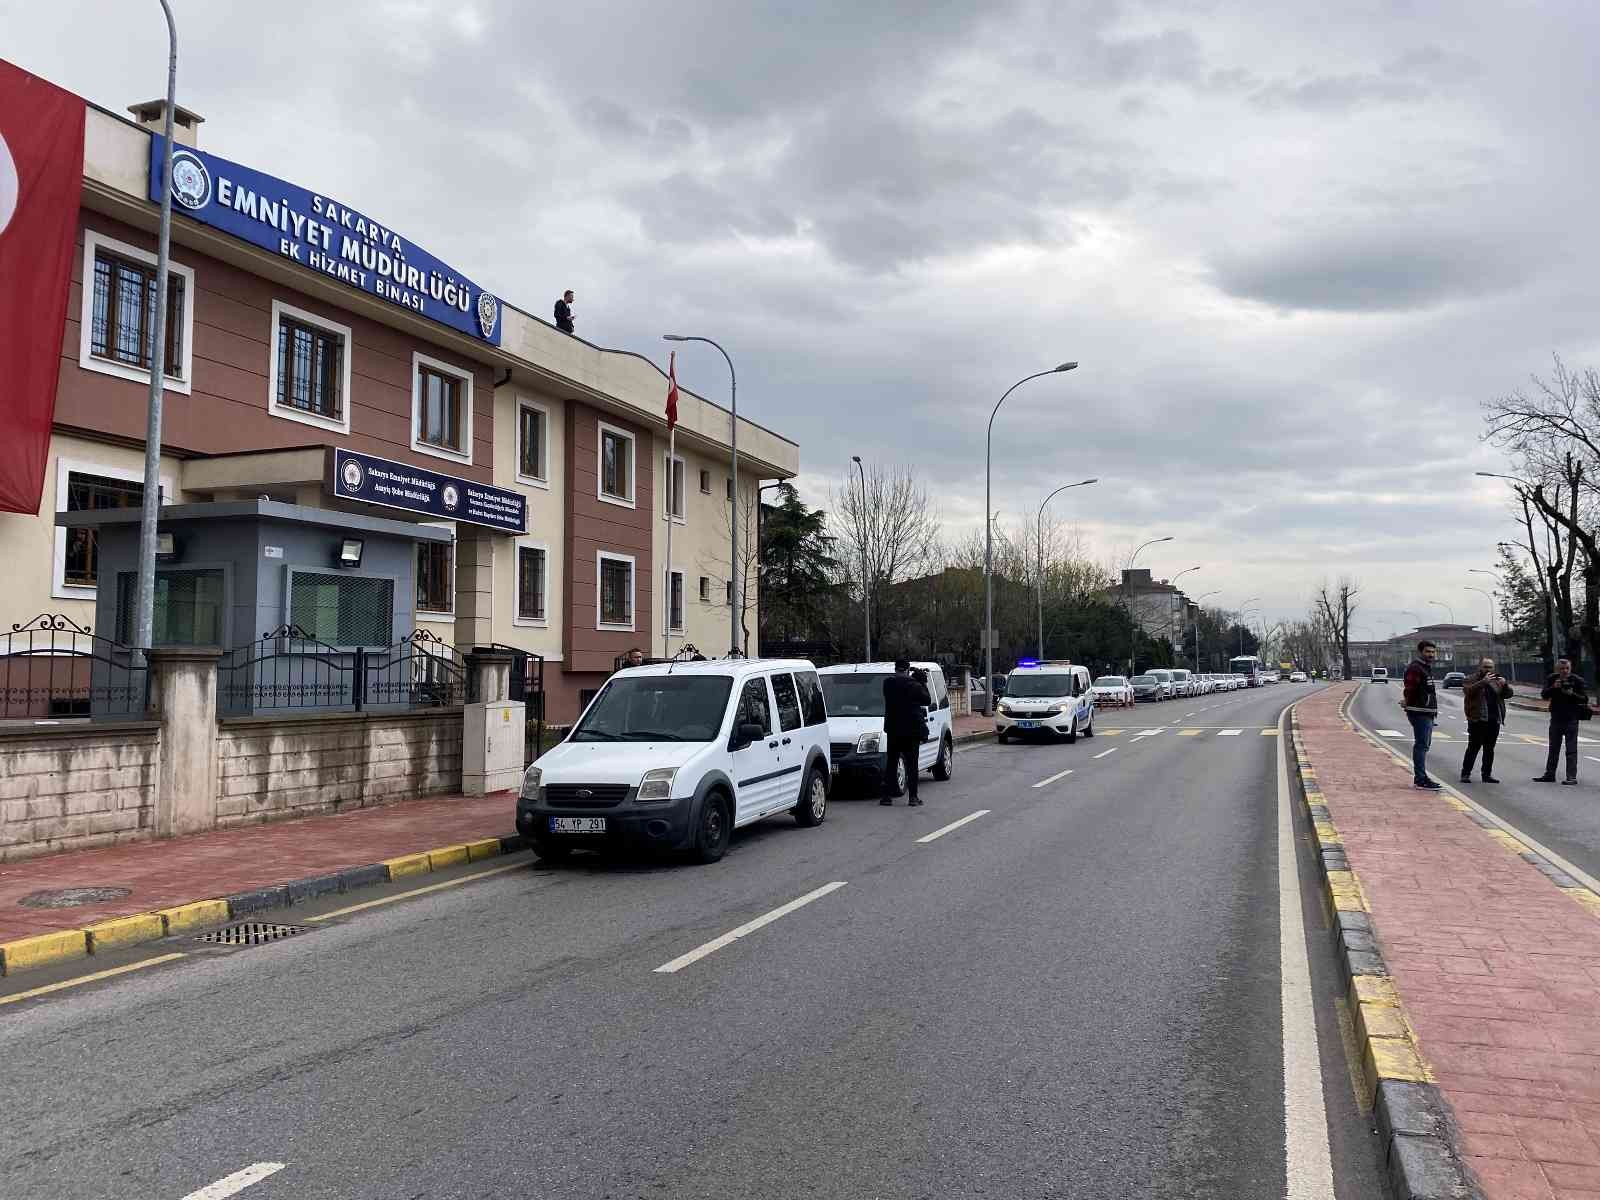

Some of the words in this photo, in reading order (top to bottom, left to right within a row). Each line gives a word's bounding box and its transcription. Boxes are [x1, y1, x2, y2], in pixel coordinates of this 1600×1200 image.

[218, 176, 333, 250] EMNİYET
[341, 235, 470, 313] MÜDÜRLÜĞÜ
[312, 195, 402, 253] SAKARYA
[280, 237, 301, 260] EK
[309, 250, 366, 288] HİZMET
[376, 279, 424, 313] BİNASI
[368, 467, 389, 480] Sakarya
[389, 472, 410, 485] Emniyet
[556, 818, 565, 830] 54
[572, 818, 582, 830] YP
[590, 818, 604, 830] 291
